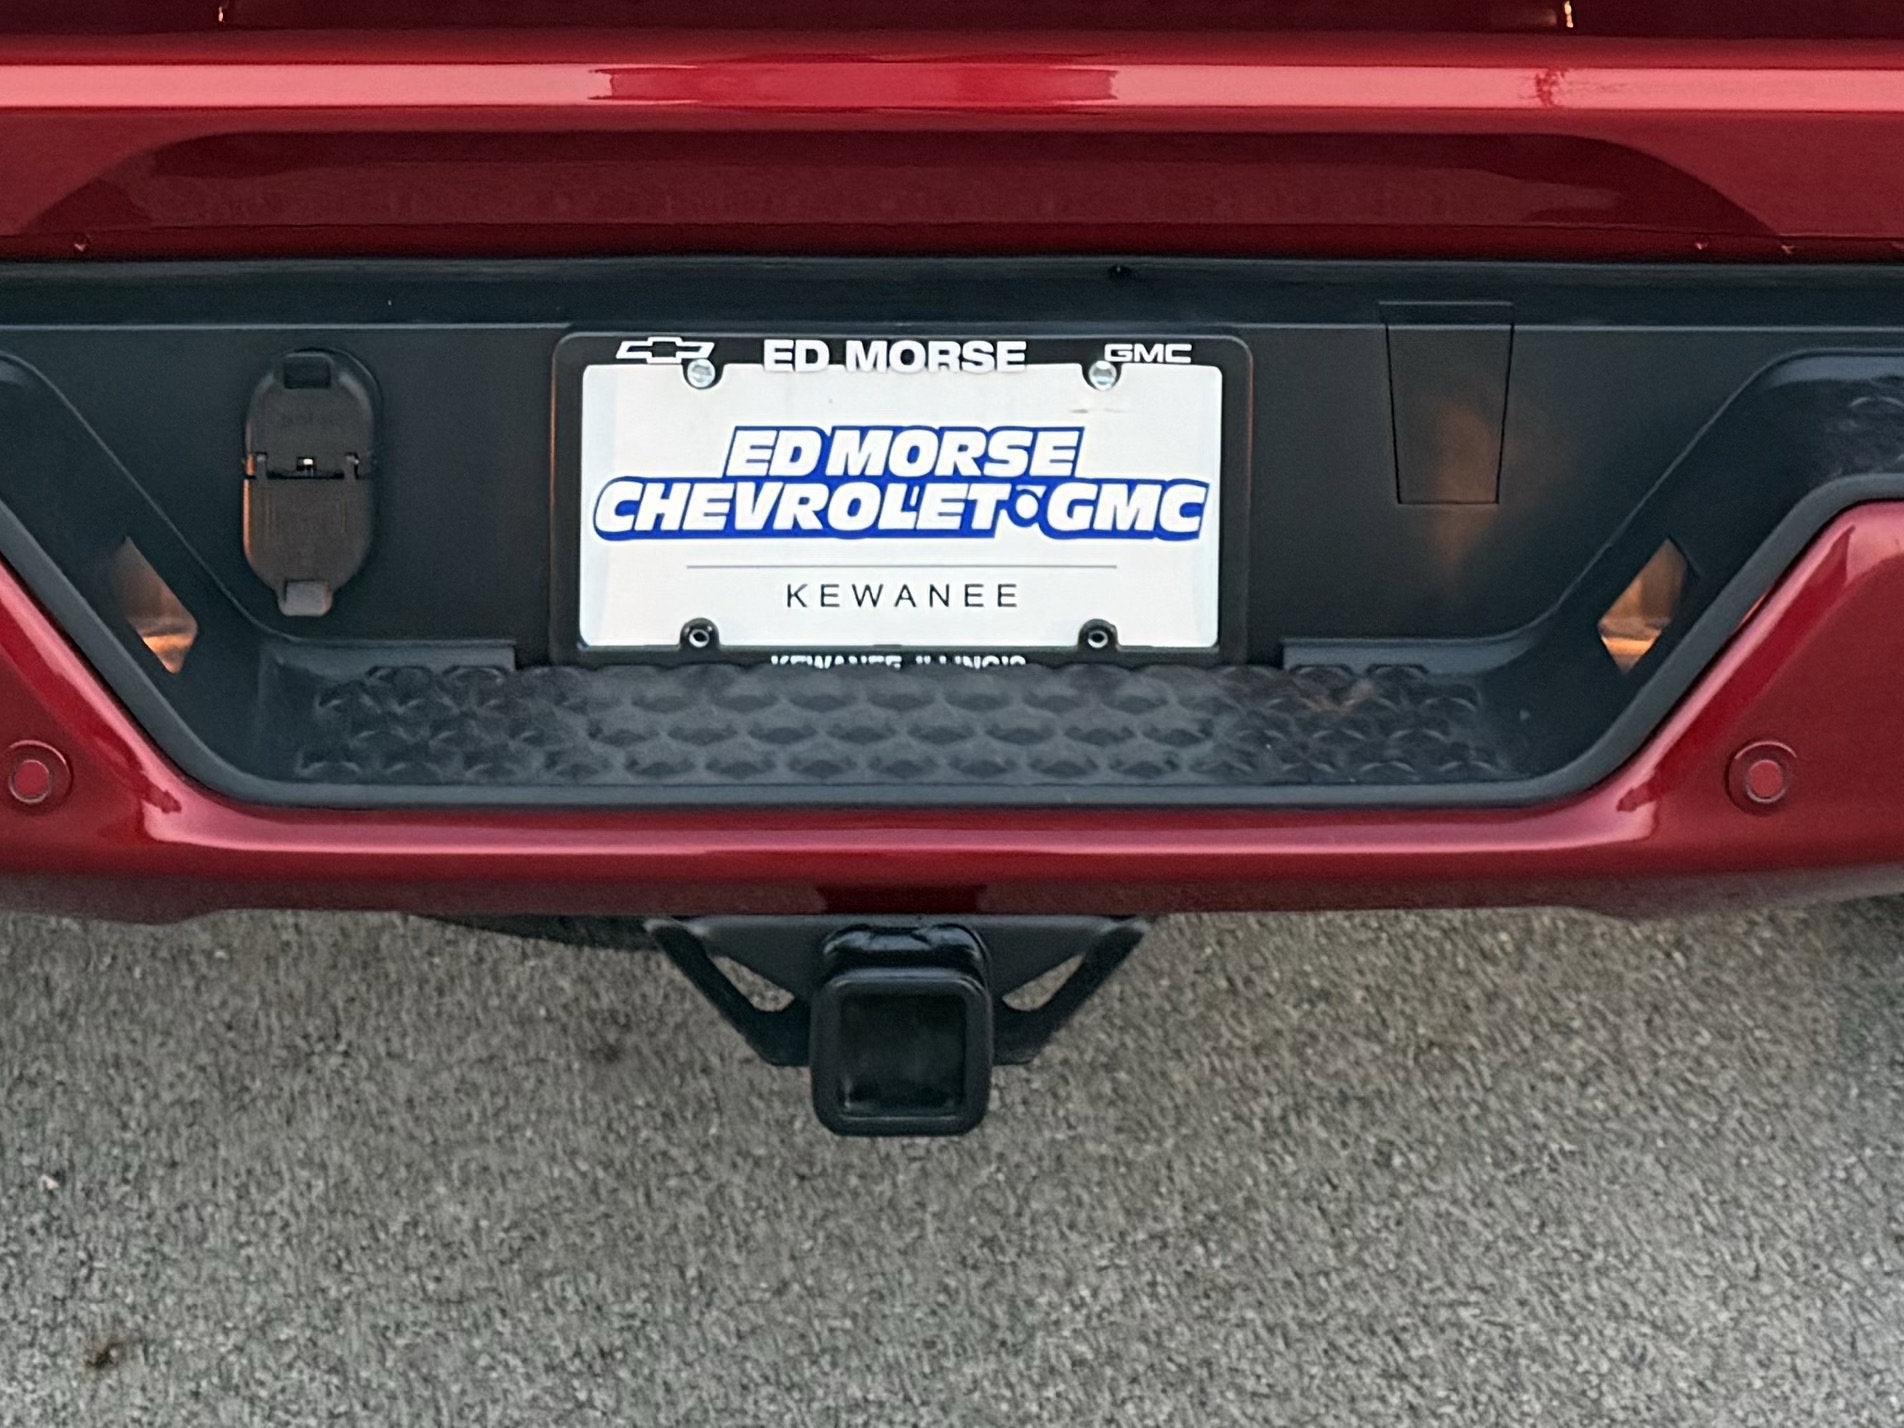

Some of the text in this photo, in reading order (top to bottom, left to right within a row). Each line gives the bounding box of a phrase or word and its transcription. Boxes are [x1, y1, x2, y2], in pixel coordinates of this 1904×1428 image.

[763, 338, 1027, 373] ED MORSE
[1104, 343, 1192, 364] GMC
[724, 427, 1082, 480] ED MORSE
[786, 584, 1018, 608] KEWANEE
